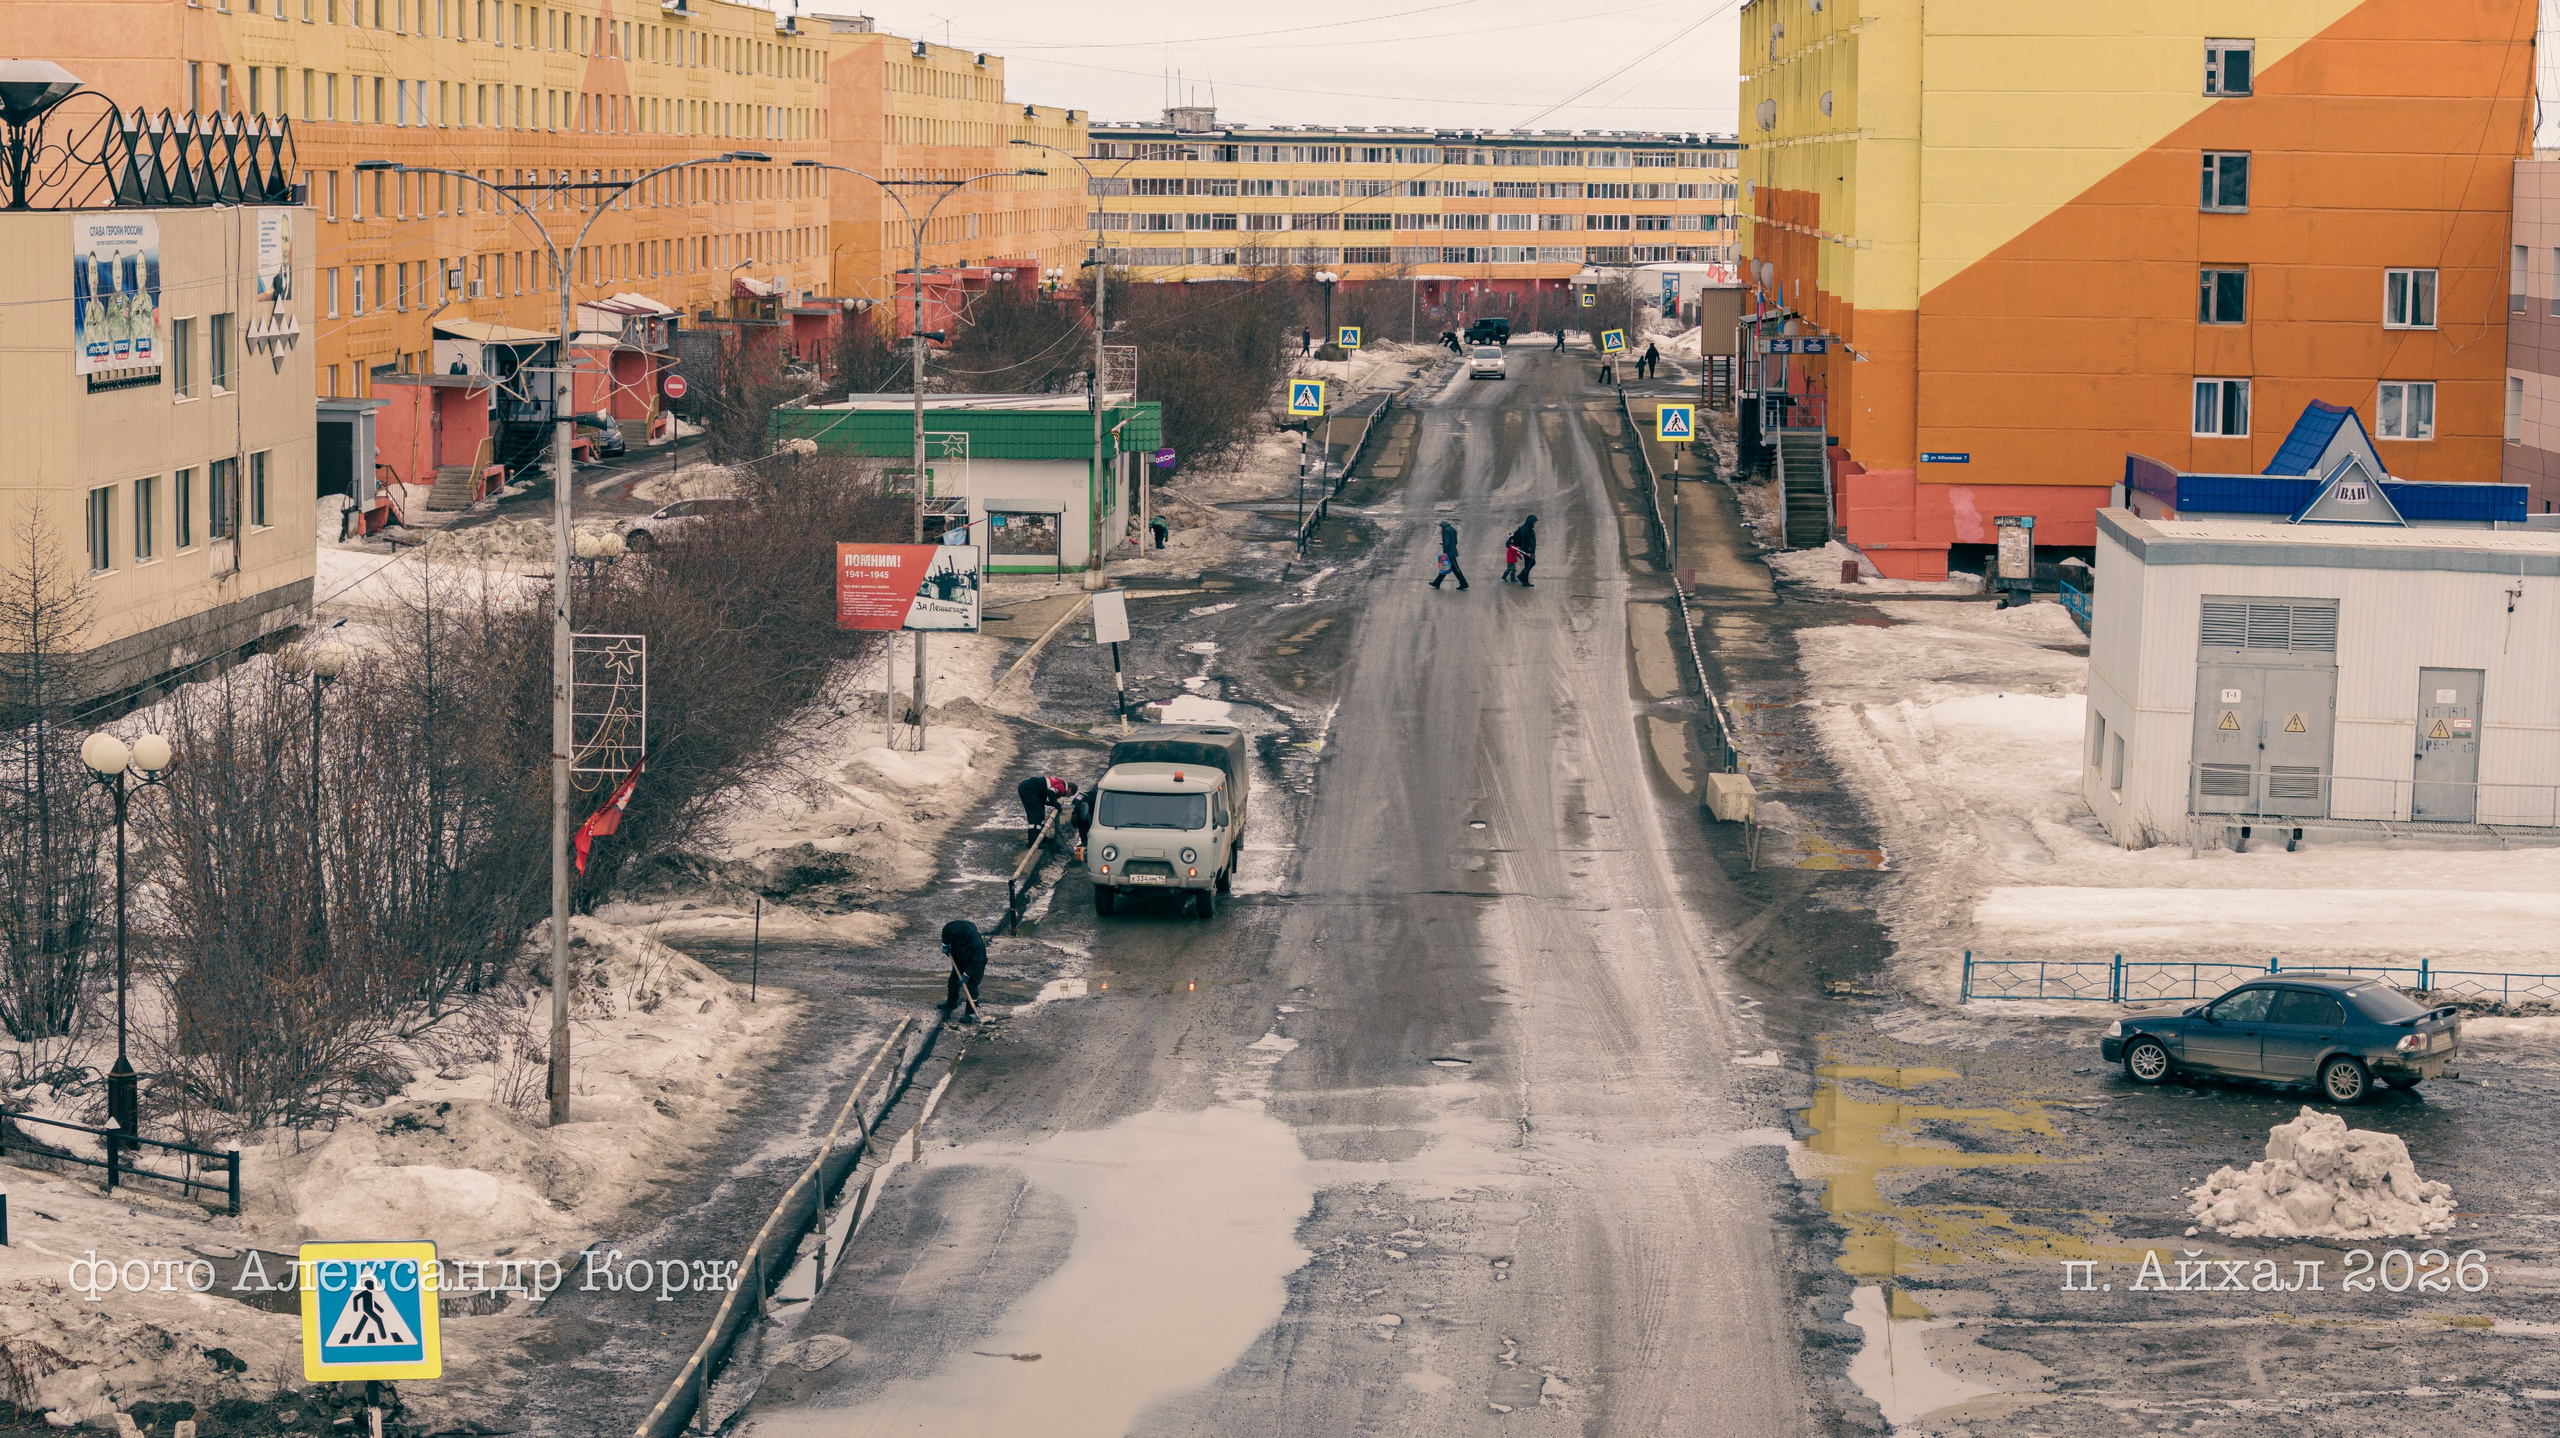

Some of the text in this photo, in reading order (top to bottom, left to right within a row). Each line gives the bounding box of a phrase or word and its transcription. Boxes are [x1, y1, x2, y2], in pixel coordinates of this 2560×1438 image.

[89, 226, 105, 237] СЛАВА
[105, 225, 124, 236] ГЕРОЯМ
[1155, 454, 1175, 464] OZON
[844, 554, 901, 568] ПОМНИМ!
